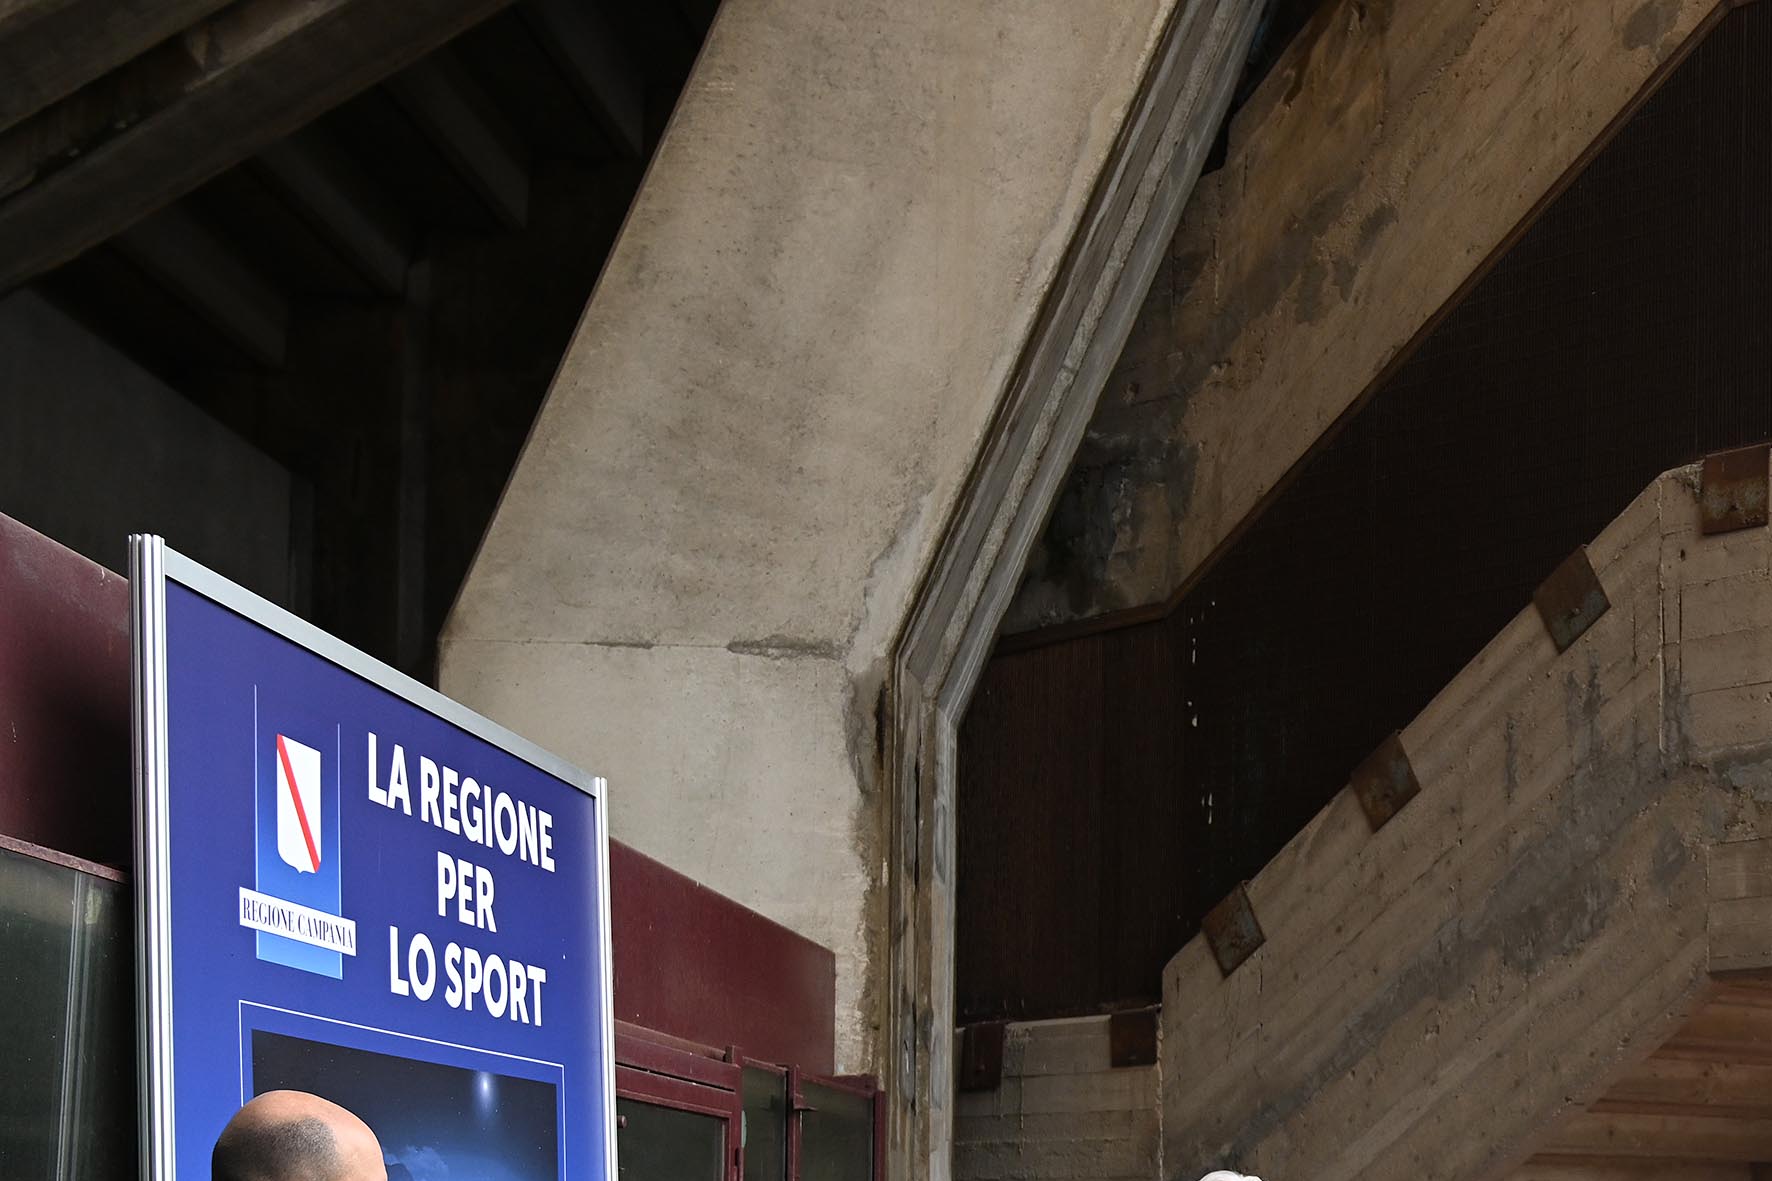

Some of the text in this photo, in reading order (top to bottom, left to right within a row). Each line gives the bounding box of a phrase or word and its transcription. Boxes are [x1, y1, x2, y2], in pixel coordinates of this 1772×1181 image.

[368, 731, 556, 873] LA REGIONE
[243, 897, 353, 949] REGIONE CAMPANIA
[437, 850, 497, 933] PER
[389, 925, 546, 1027] LO SPORT
